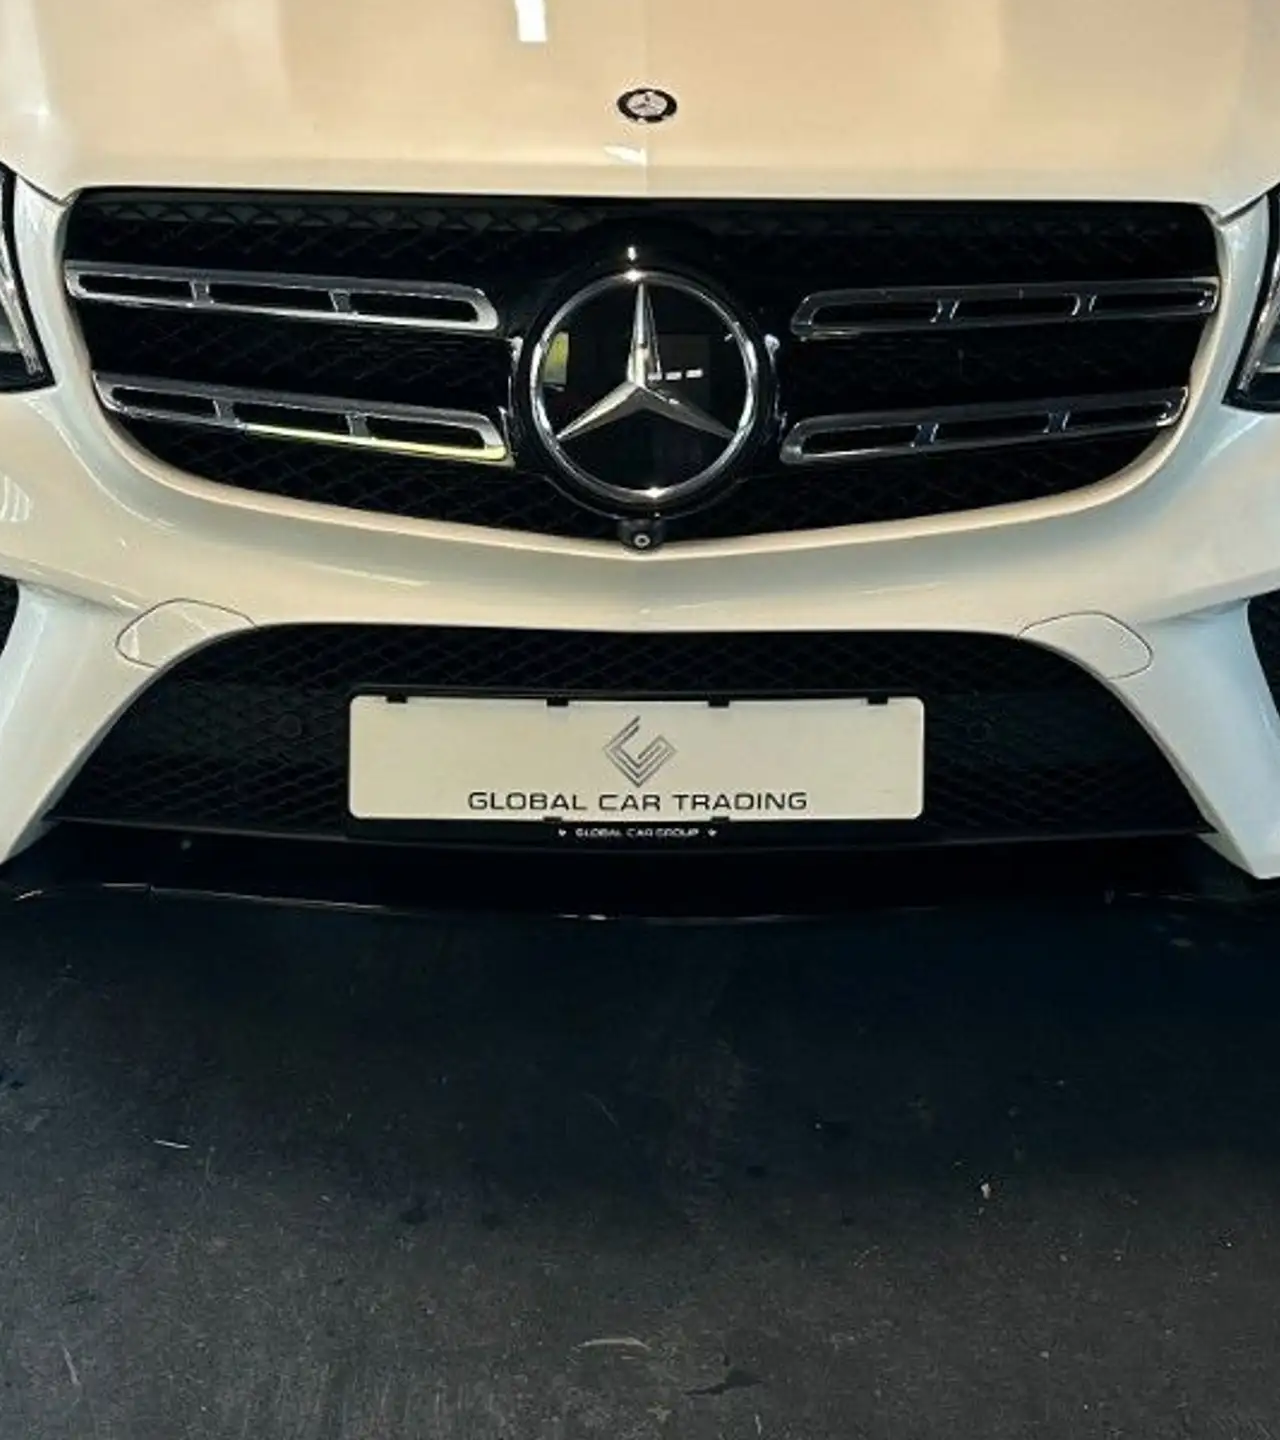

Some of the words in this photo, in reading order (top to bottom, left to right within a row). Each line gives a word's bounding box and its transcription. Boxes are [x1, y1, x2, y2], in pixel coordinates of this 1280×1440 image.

[467, 791, 587, 811] GLOBAL
[598, 791, 661, 812] CAR
[672, 791, 808, 811] TRADING
[574, 827, 622, 838] GLOBAL
[625, 827, 654, 838] CAR
